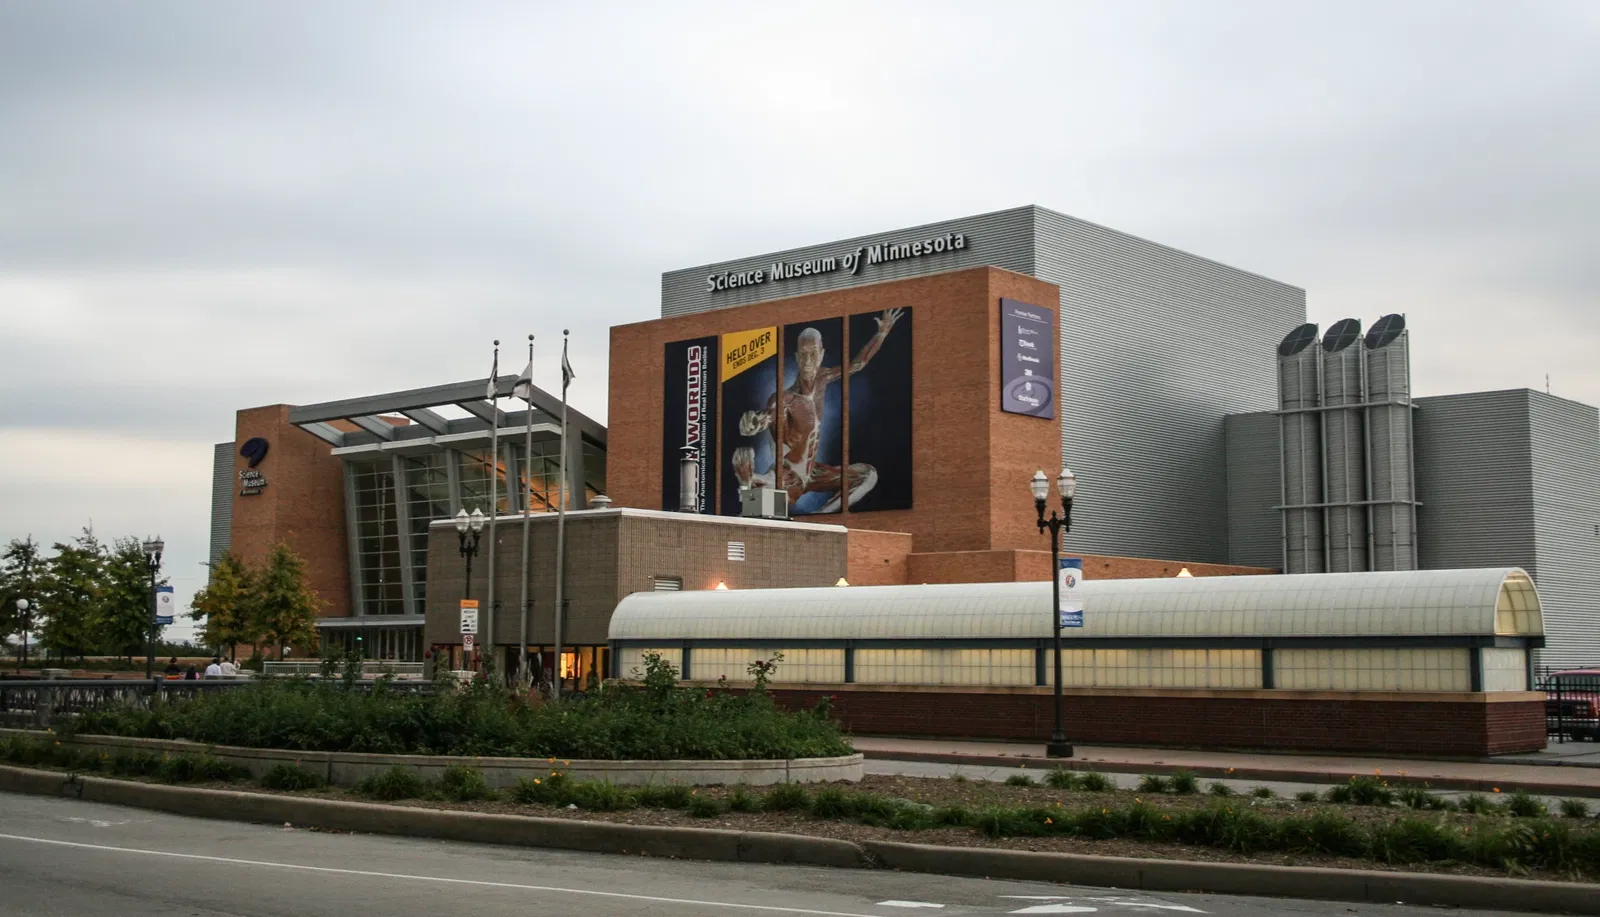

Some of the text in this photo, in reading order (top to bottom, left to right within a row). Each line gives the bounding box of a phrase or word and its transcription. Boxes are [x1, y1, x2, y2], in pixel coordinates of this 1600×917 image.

[706, 233, 965, 292] Science Museum of Minnesota
[727, 331, 771, 364] HELD OVER
[733, 347, 765, 370] ENDS DEC. 3
[686, 345, 701, 447] WORLDS
[701, 413, 707, 421] of
[238, 470, 259, 480] Science
[243, 478, 265, 487] Museum
